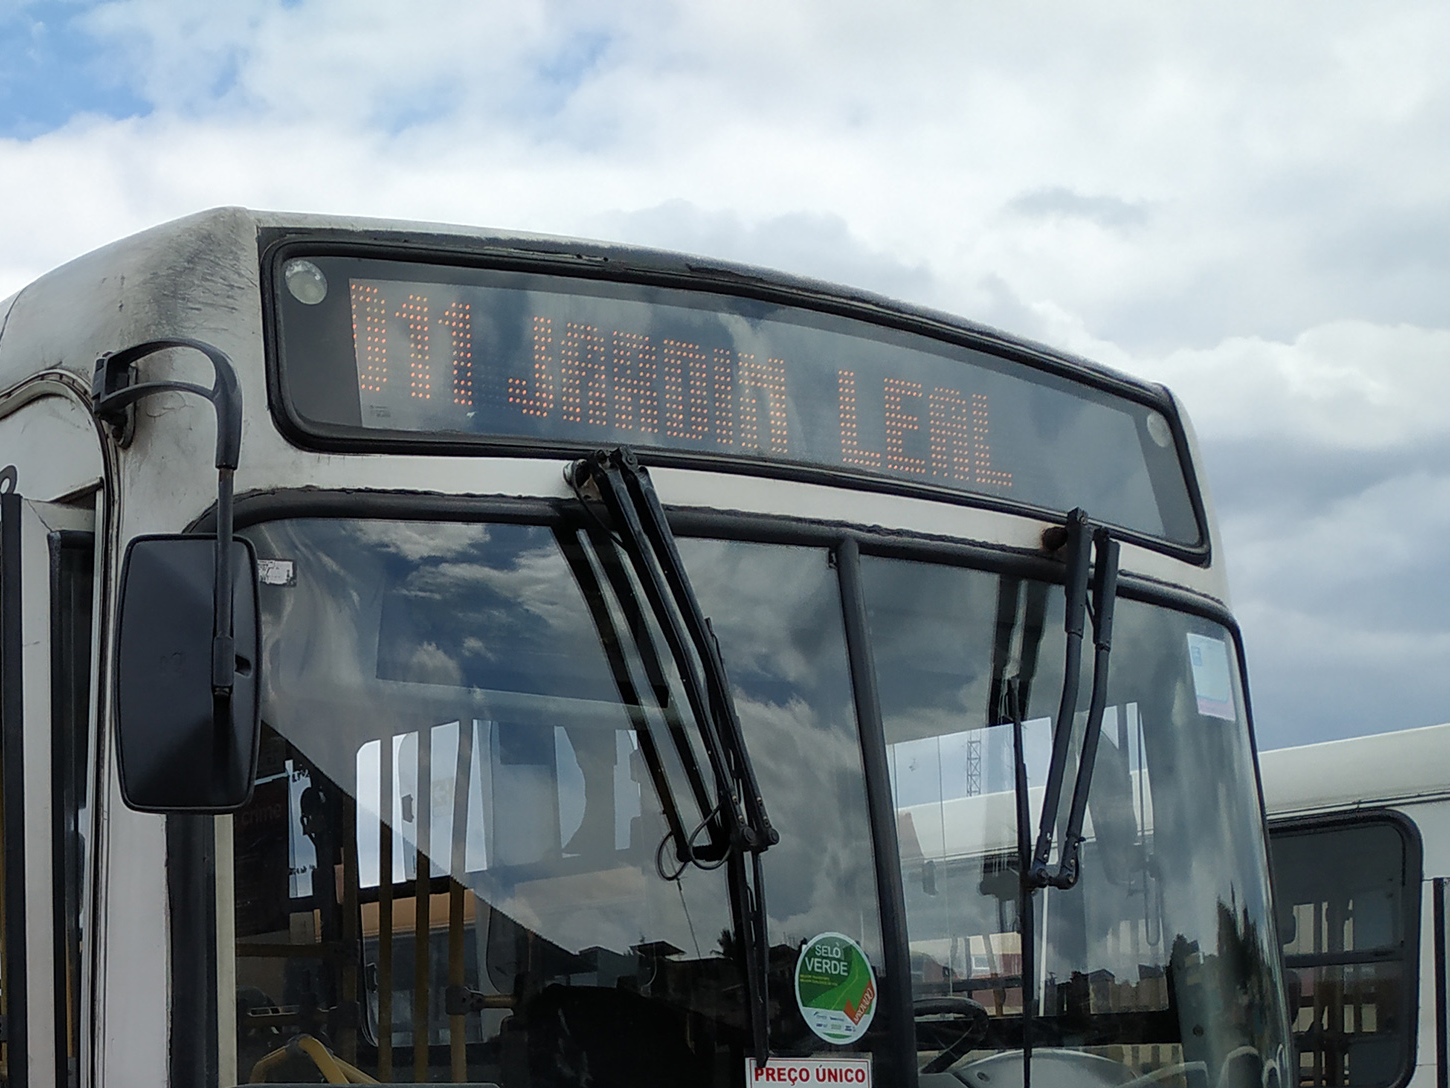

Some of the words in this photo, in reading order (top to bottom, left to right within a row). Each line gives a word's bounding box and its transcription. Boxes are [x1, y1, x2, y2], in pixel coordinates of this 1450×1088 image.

[837, 369, 1013, 486] LEAL
[804, 957, 849, 976] VERDE
[754, 1067, 810, 1086] PREÇO
[815, 1064, 866, 1083] ÚNICO
